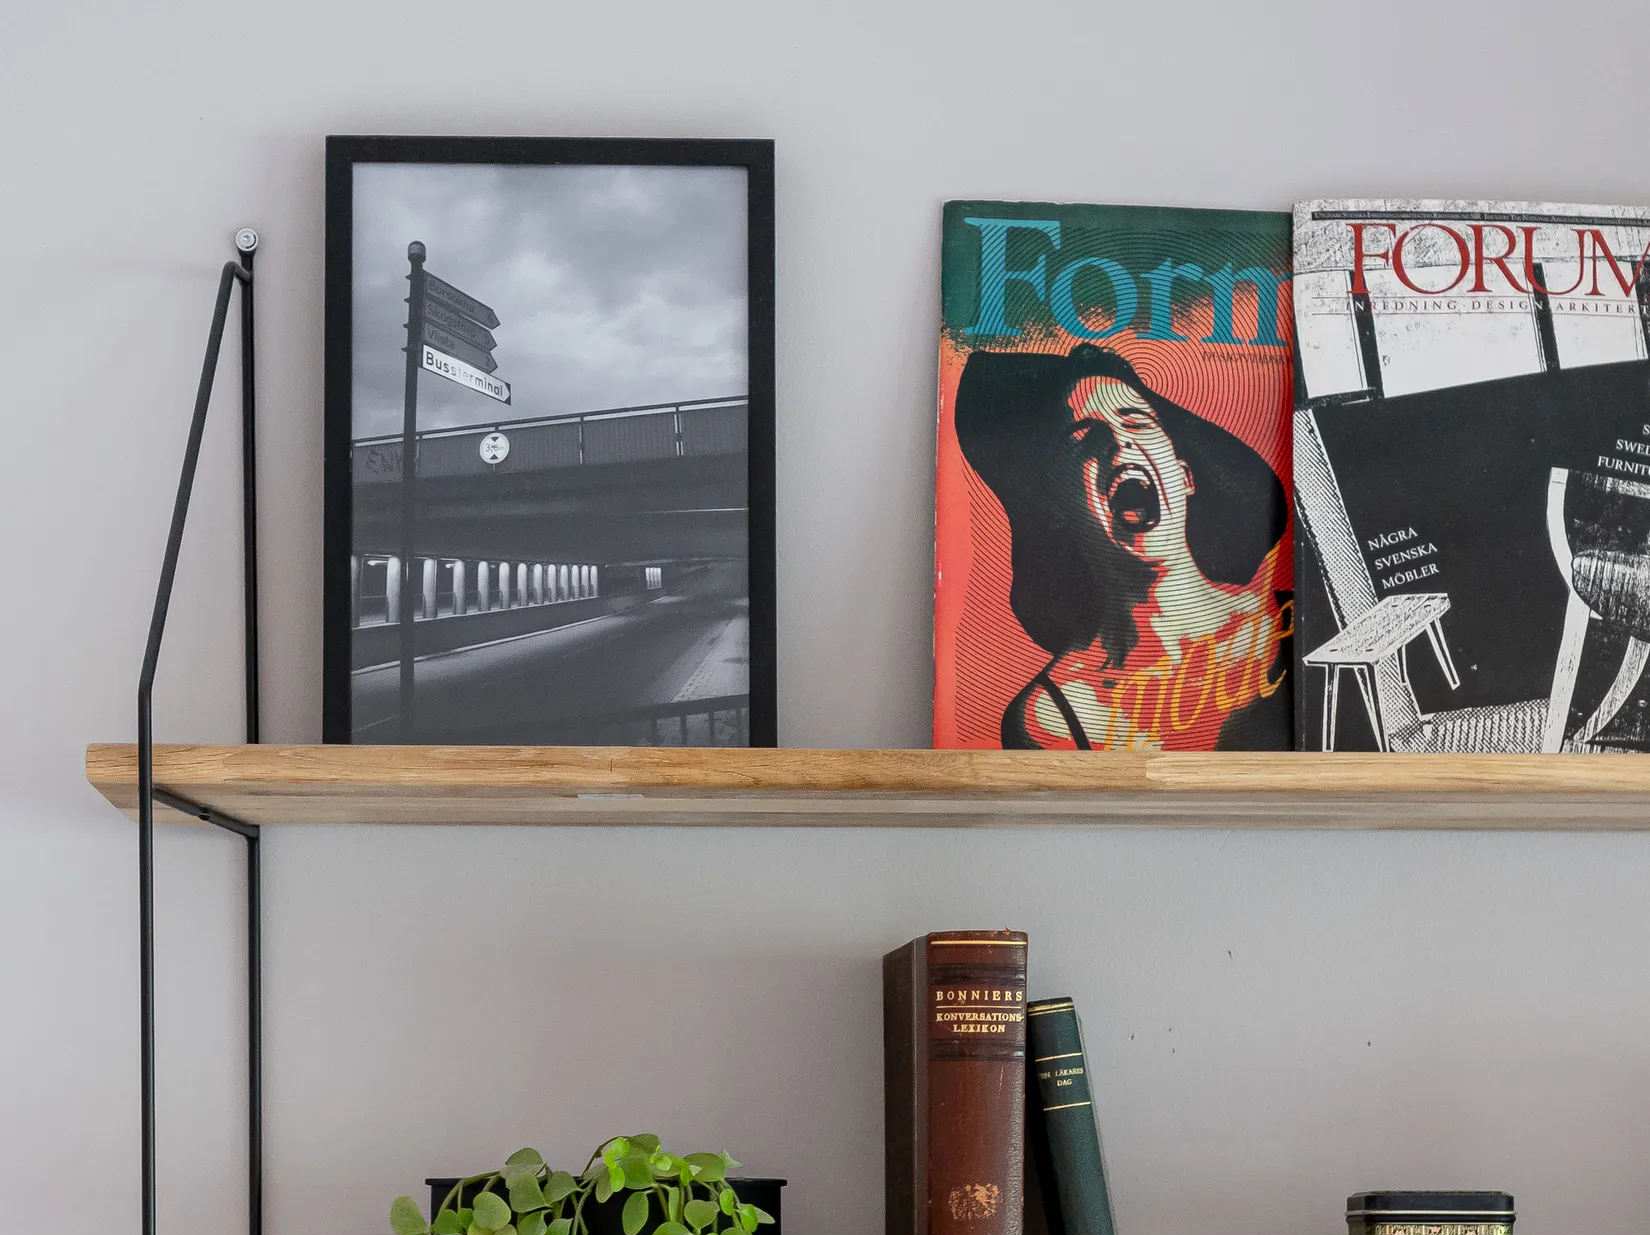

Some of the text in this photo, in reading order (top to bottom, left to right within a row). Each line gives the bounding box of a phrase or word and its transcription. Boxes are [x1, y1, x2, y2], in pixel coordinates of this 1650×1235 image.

[1472, 300, 1543, 311] DESIGN
[426, 350, 503, 397] Bussterminal
[1597, 455, 1650, 476] FURNIT
[1367, 527, 1418, 551] NÅGRA
[1374, 542, 1438, 570] SVENSKA
[1381, 563, 1440, 589] MÖBLER
[936, 990, 1023, 1001] BONNIERS
[953, 1024, 1006, 1033] LEXIKON
[1057, 1079, 1072, 1087] DAG
